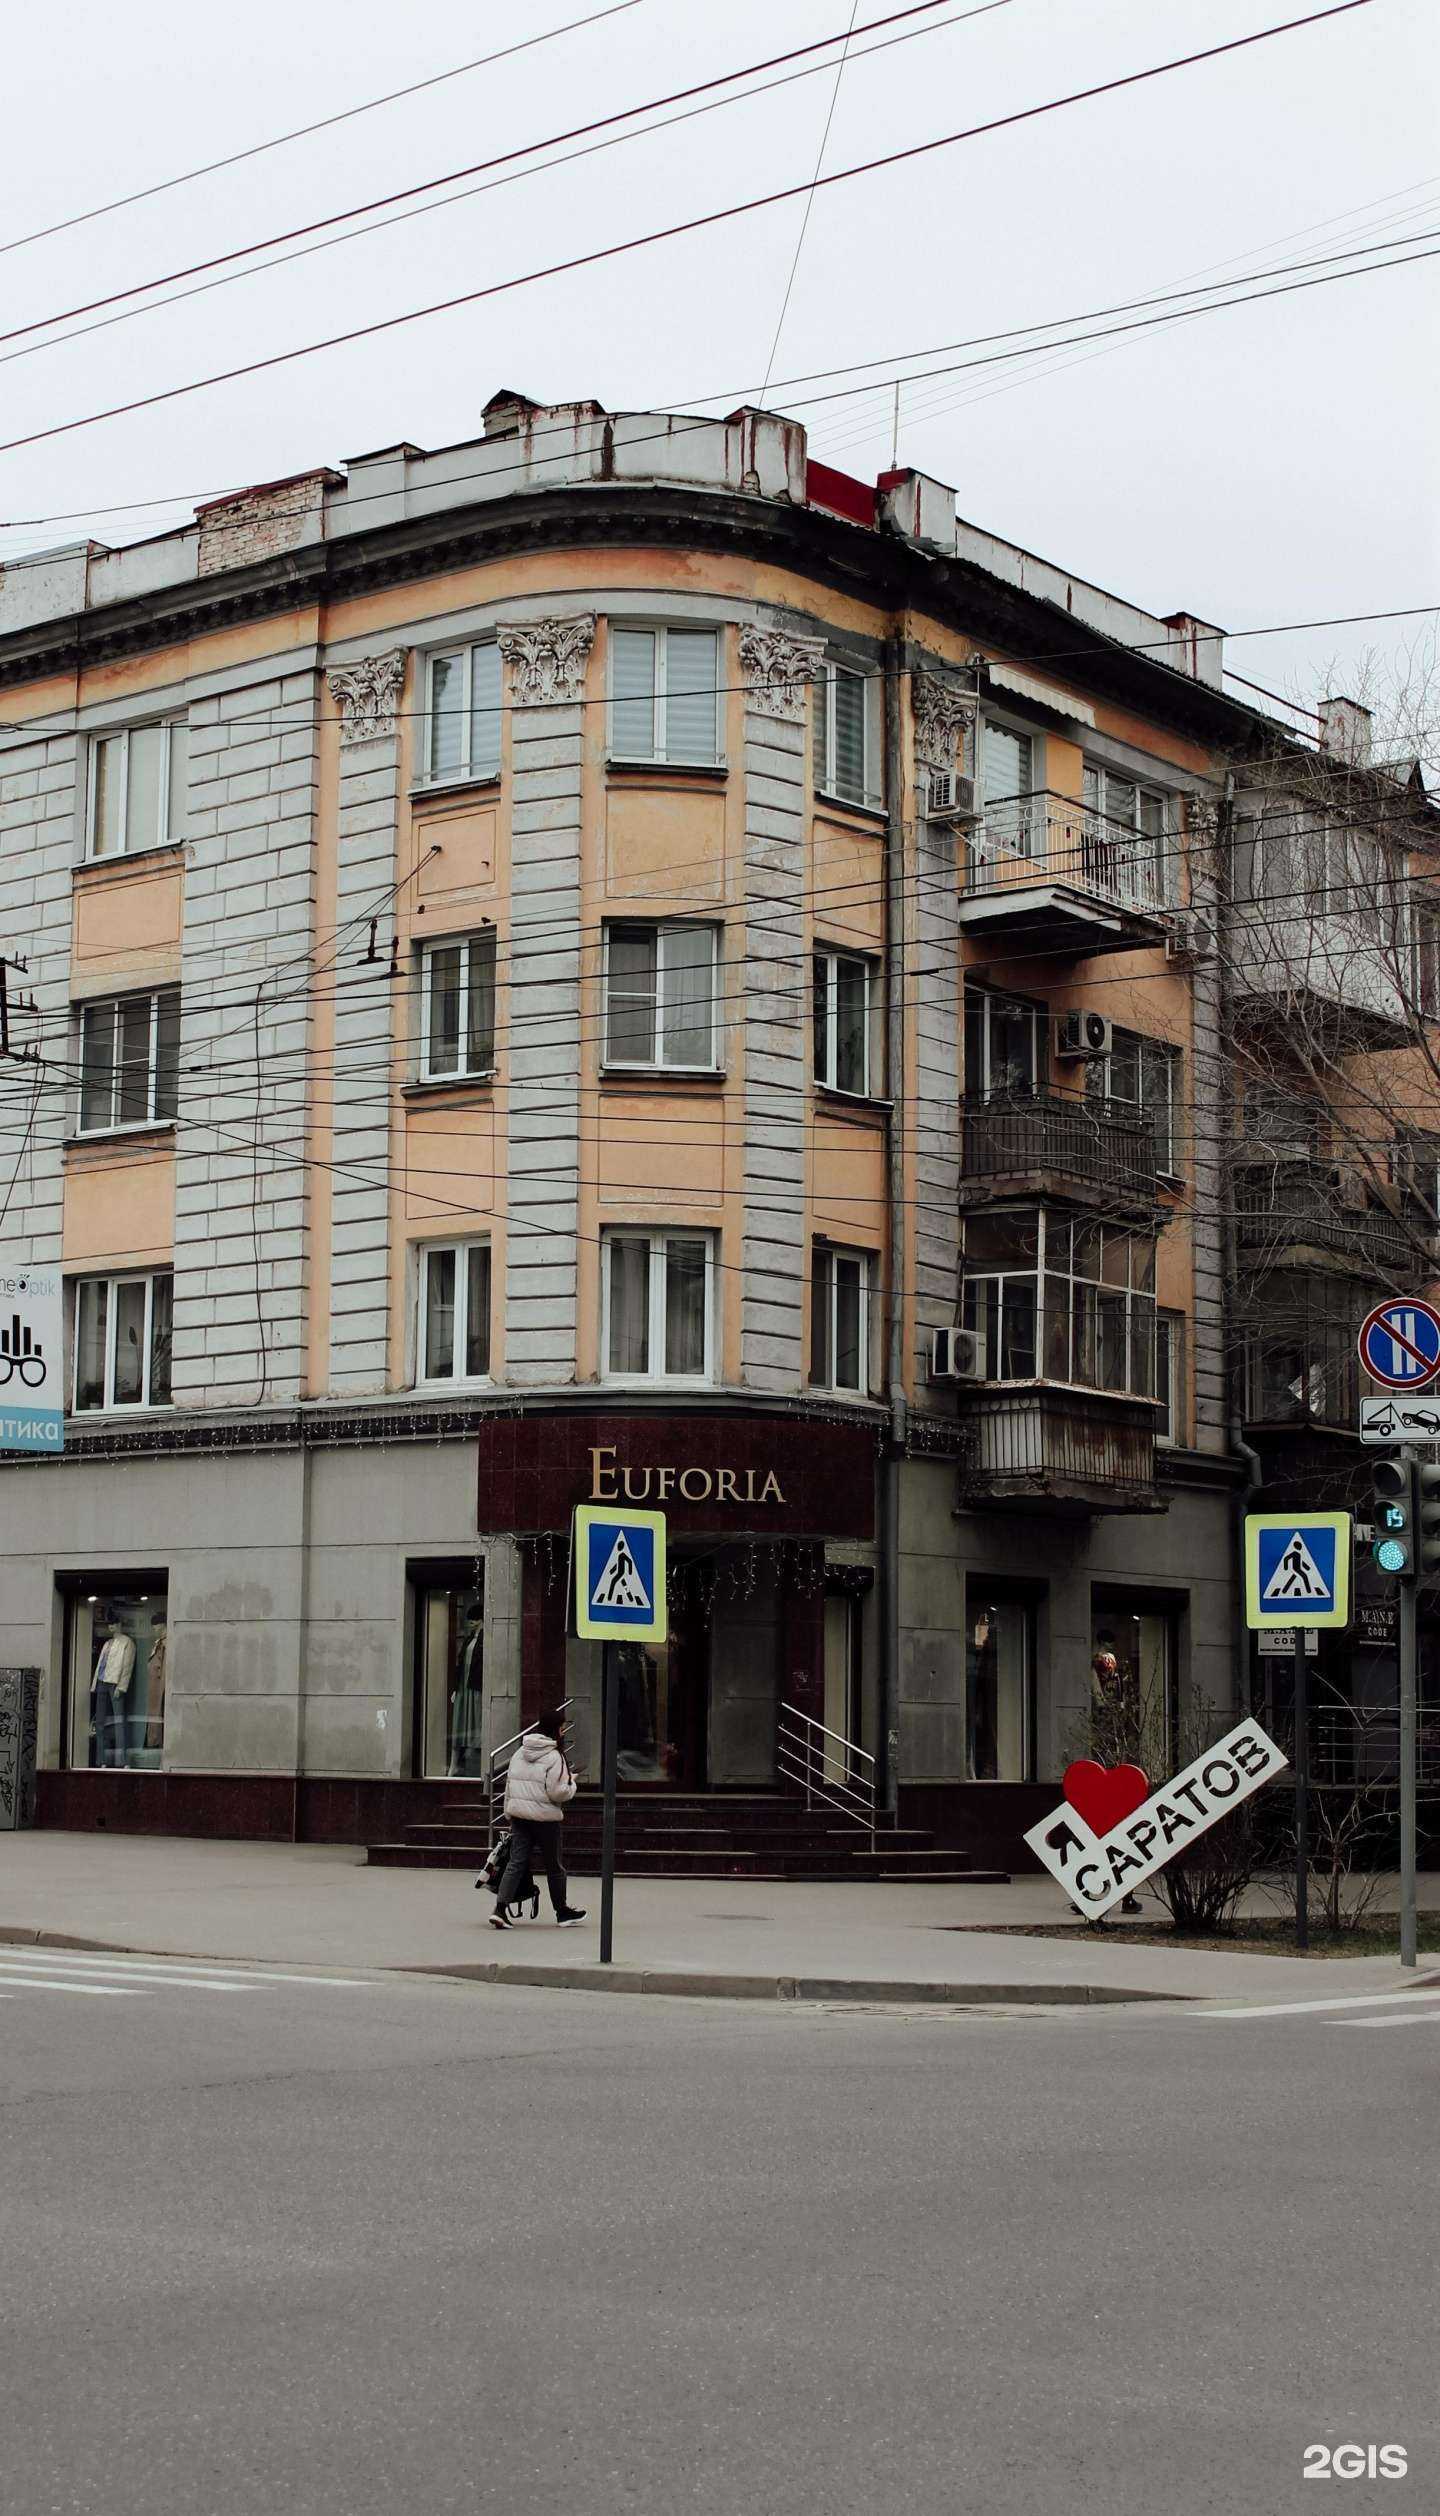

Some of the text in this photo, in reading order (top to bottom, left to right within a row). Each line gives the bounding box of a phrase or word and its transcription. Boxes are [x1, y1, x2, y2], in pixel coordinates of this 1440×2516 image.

[588, 1445, 787, 1503] EUFORIA
[1367, 1626, 1389, 1637] CODE
[1045, 1821, 1086, 1867] Я
[1075, 1735, 1271, 1902] САРАТОВ
